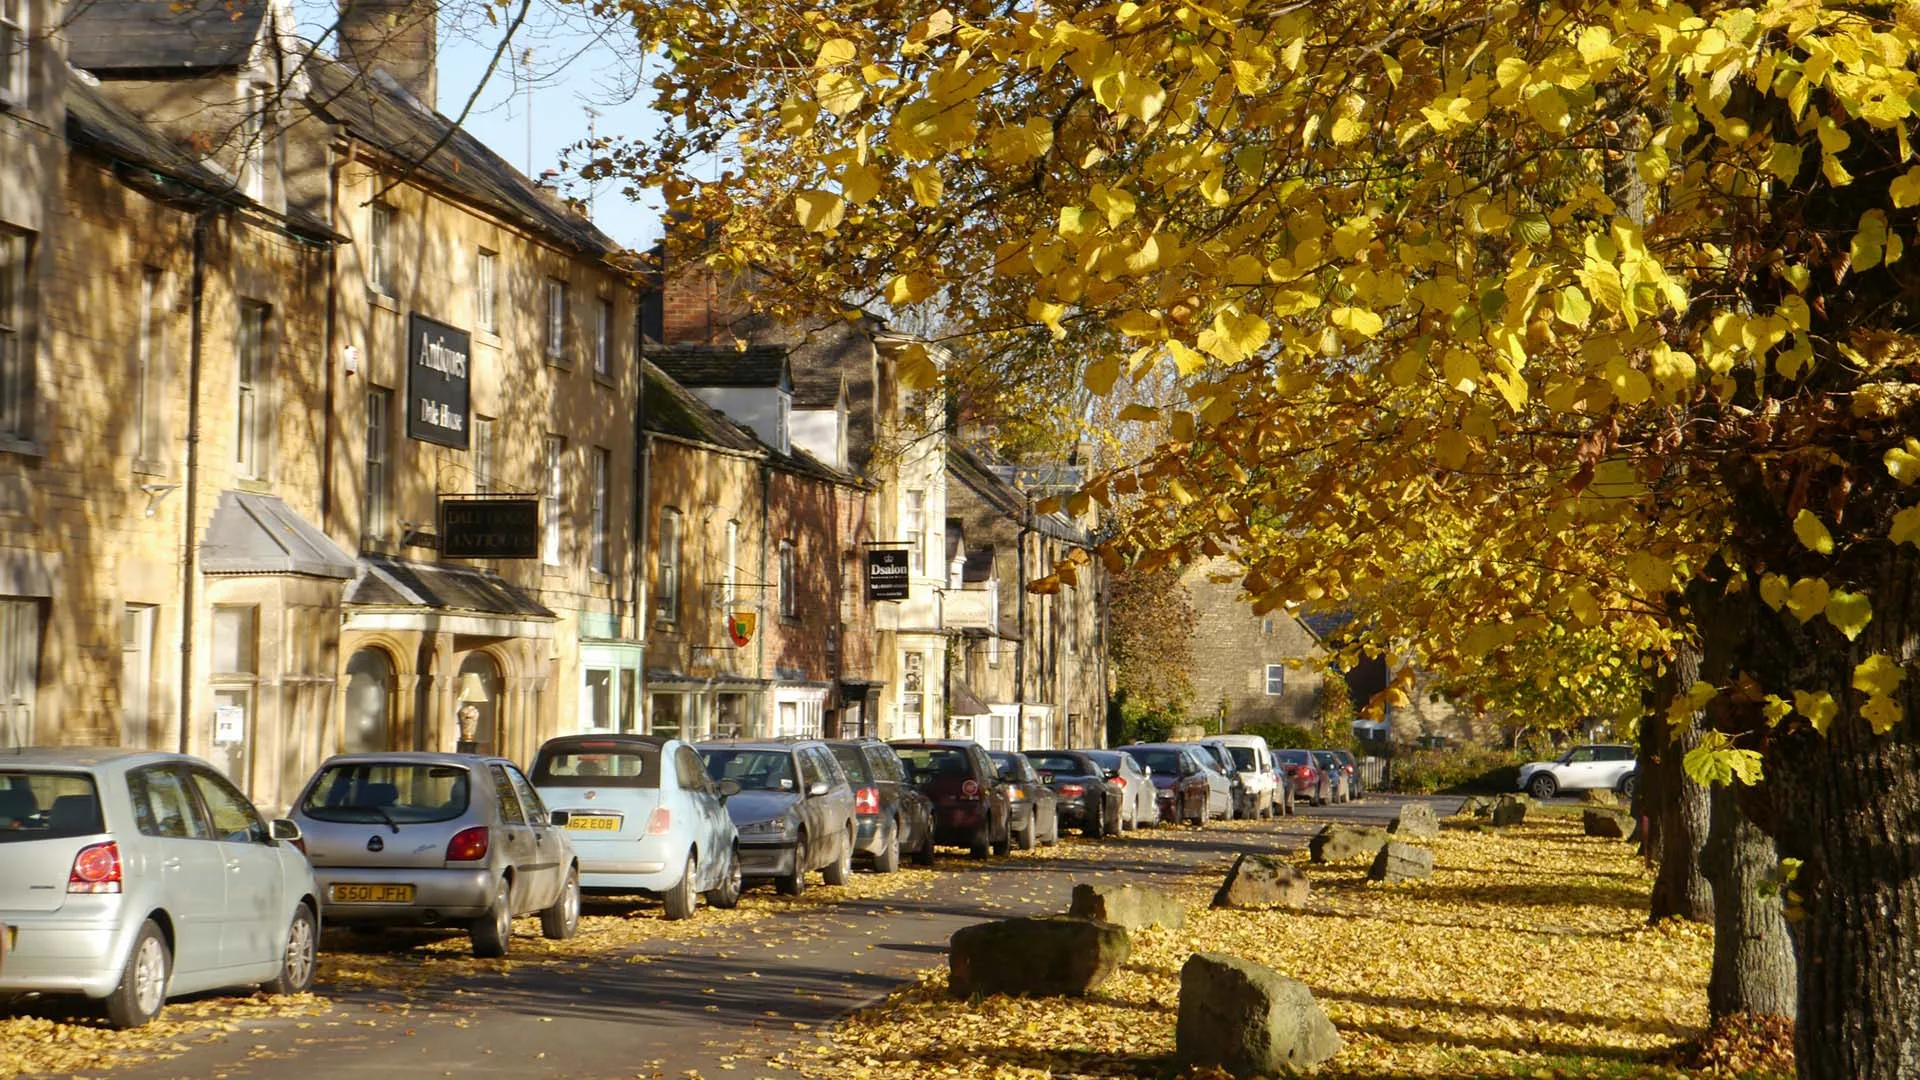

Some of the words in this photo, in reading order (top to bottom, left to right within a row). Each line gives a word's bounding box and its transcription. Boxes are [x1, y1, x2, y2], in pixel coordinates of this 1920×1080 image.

[419, 331, 466, 382] Antiques
[421, 397, 439, 425] Dale
[440, 402, 463, 431] House
[871, 563, 907, 576] Dsalon
[375, 886, 407, 900] JFH
